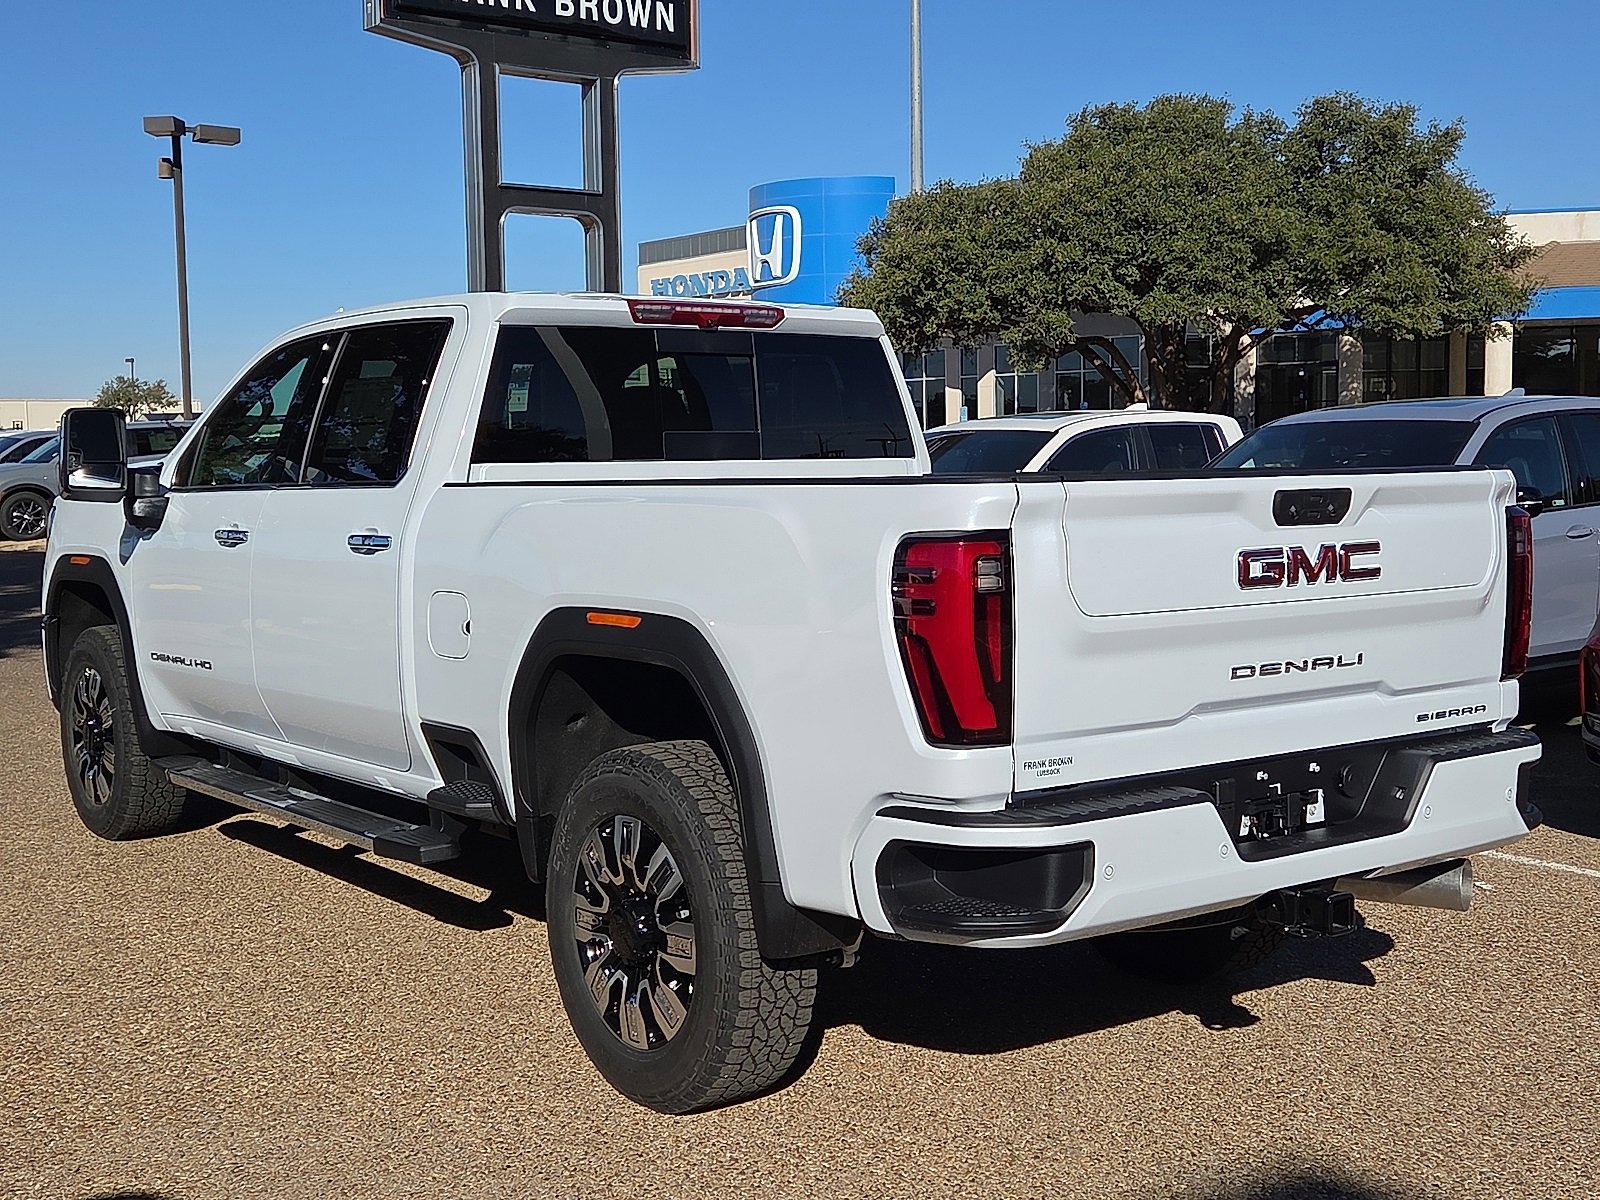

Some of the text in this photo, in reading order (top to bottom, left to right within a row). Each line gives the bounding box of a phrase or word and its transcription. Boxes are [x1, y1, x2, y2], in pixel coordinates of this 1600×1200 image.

[555, 0, 675, 32] BROWN
[651, 267, 752, 297] HONDA
[1237, 540, 1382, 591] GMC
[150, 652, 213, 671] DENALI HD
[1230, 652, 1364, 681] DENALI
[1415, 703, 1487, 723] SIERRA
[1023, 756, 1073, 771] FRANK BROWN
